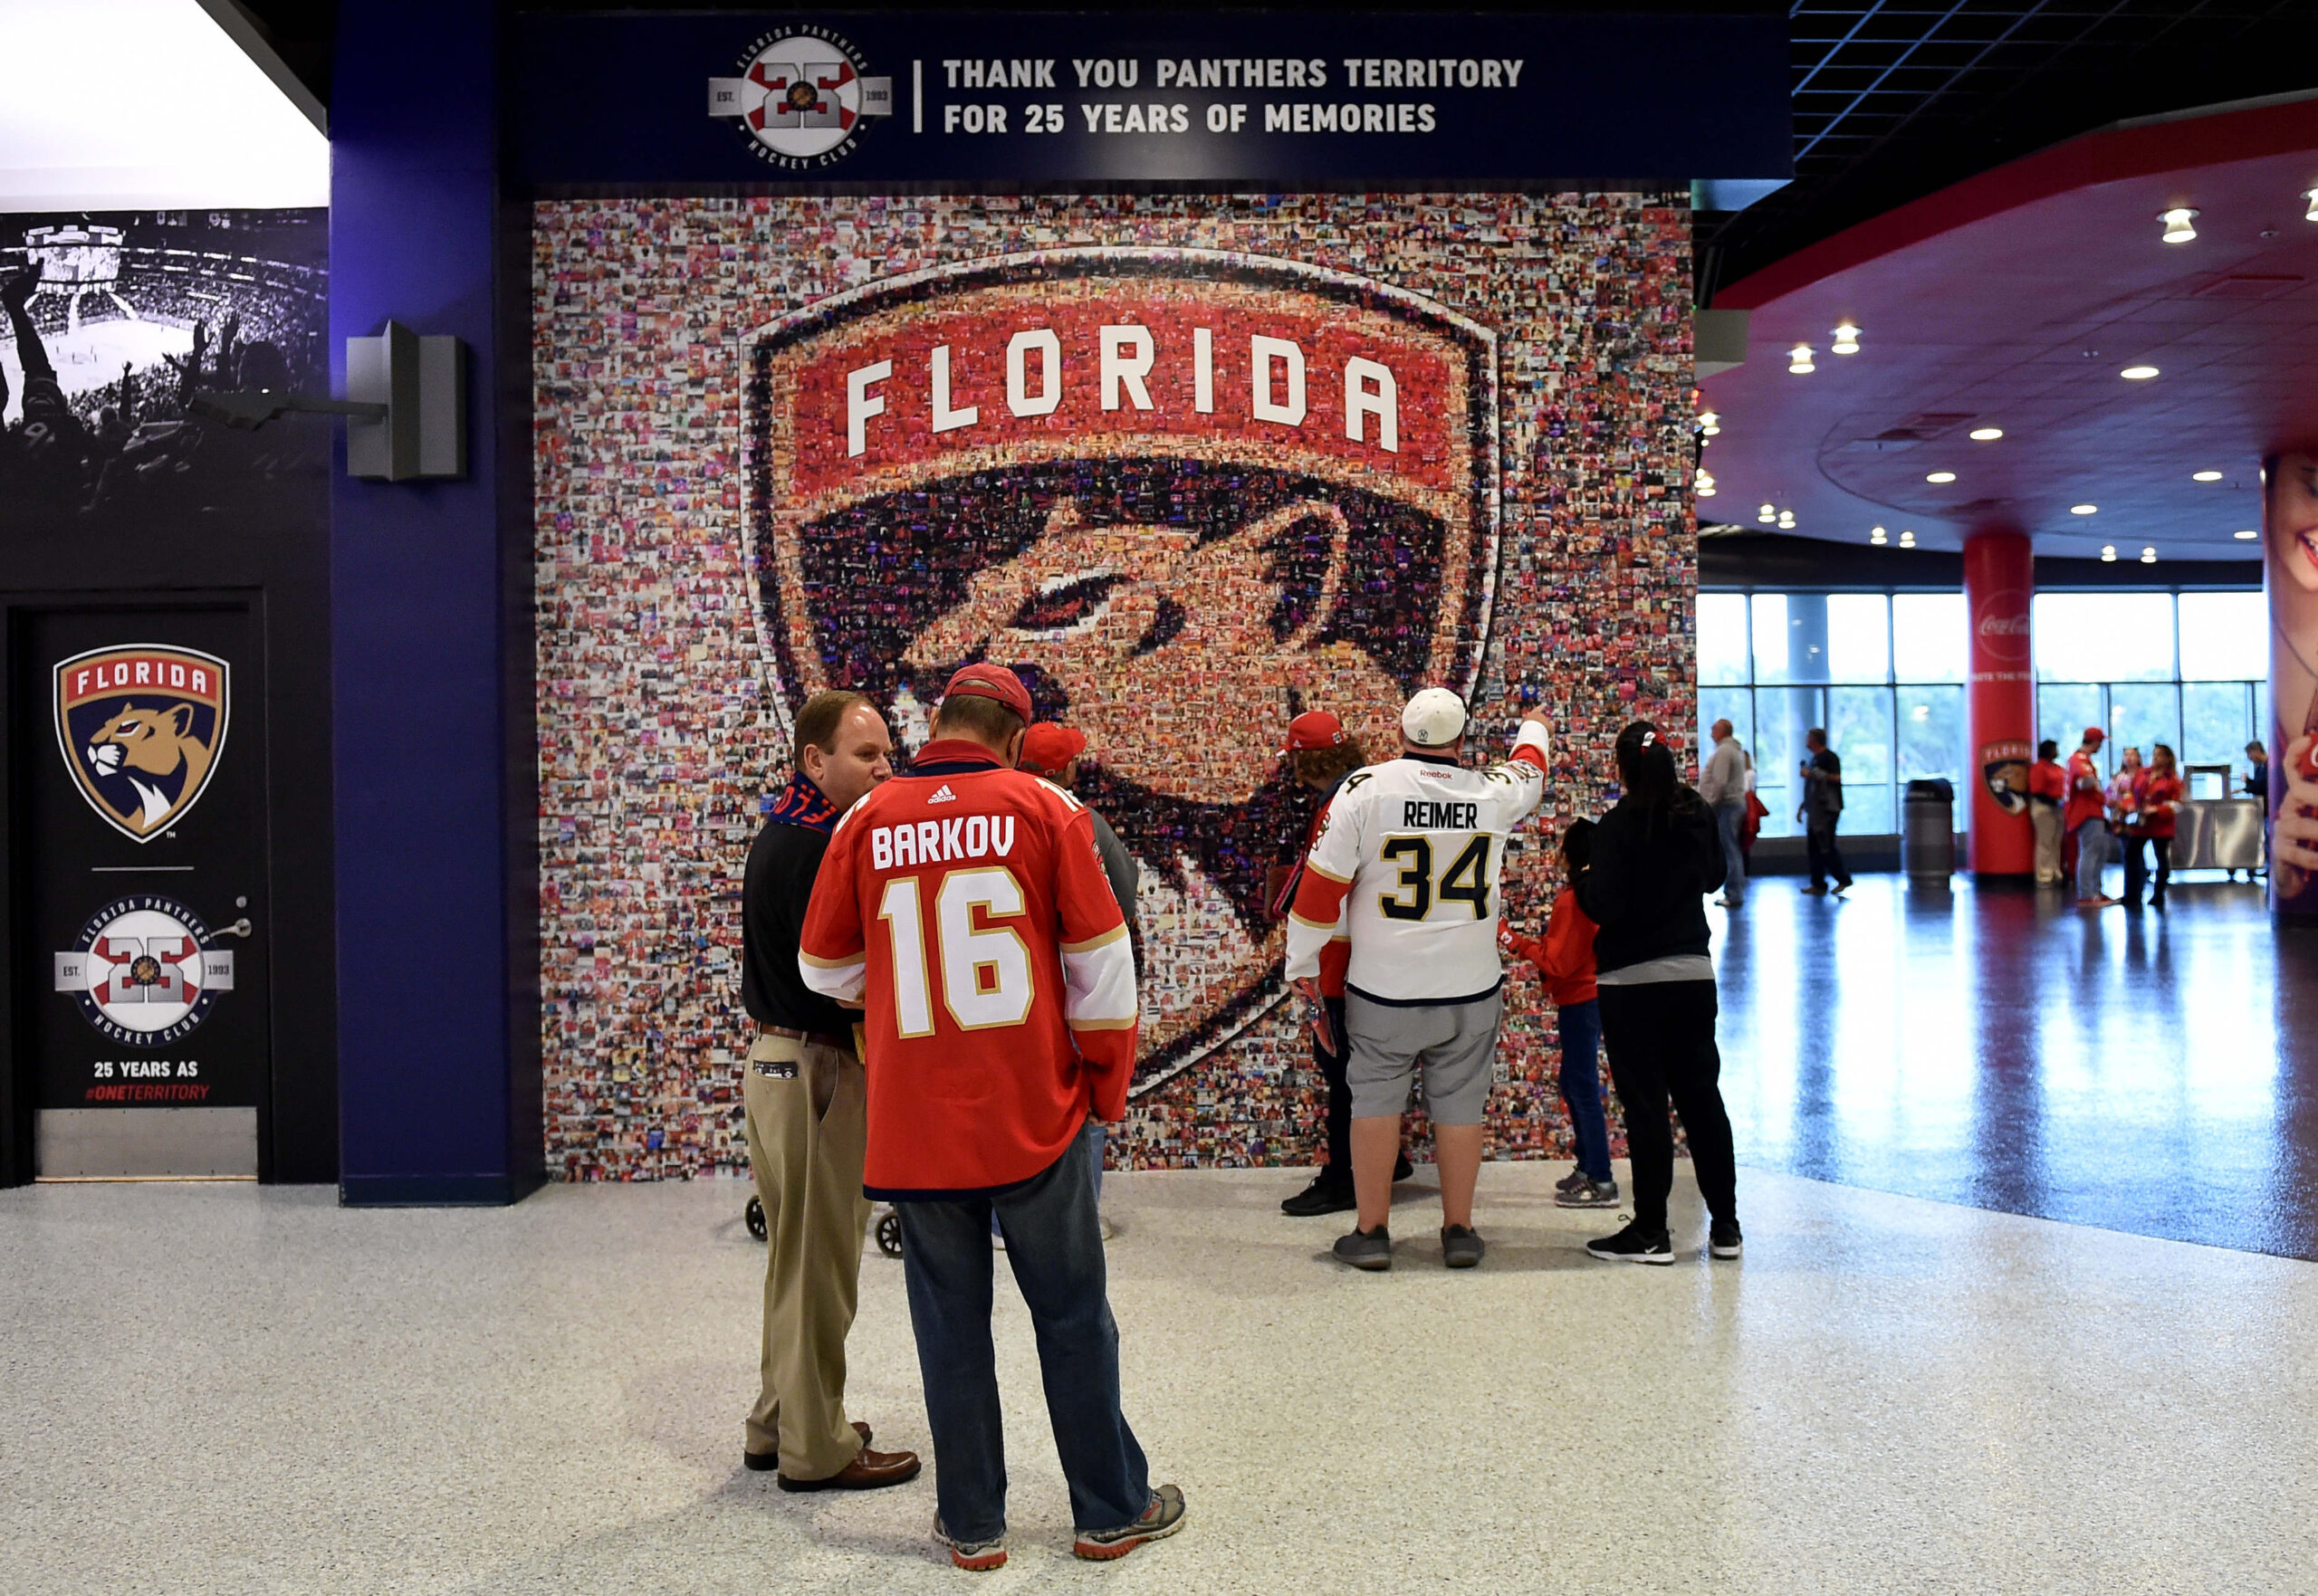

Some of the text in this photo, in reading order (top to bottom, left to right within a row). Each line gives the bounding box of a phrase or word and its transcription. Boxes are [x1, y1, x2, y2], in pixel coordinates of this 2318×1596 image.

[737, 24, 868, 72] FLORIDA PANTHERS
[943, 59, 1524, 89] THANK YOU PANTHERS TERRITORY
[716, 91, 735, 102] EST.
[866, 91, 889, 102] 1993
[943, 104, 1437, 134] FOR 25 YEARS OF MEMORIES
[747, 138, 857, 170] HOCKEY CLUB
[847, 324, 1399, 458] FLORIDA
[77, 662, 207, 694] FLORIDA
[1420, 769, 1452, 779] Reebok
[927, 794, 957, 805] adidas
[1403, 800, 1478, 829] REIMER
[872, 816, 1015, 870] BARKOV
[1378, 832, 1493, 922] 34
[81, 897, 210, 945] FLORIDA PANTHERS
[876, 865, 1036, 1040] 16
[62, 965, 81, 977] EST.
[207, 964, 230, 976] 1993
[93, 1012, 199, 1046] HOCKEY CLUB
[94, 1061, 198, 1078] 25 YEARS AS
[85, 1085, 210, 1101] #ONETERRITORY
